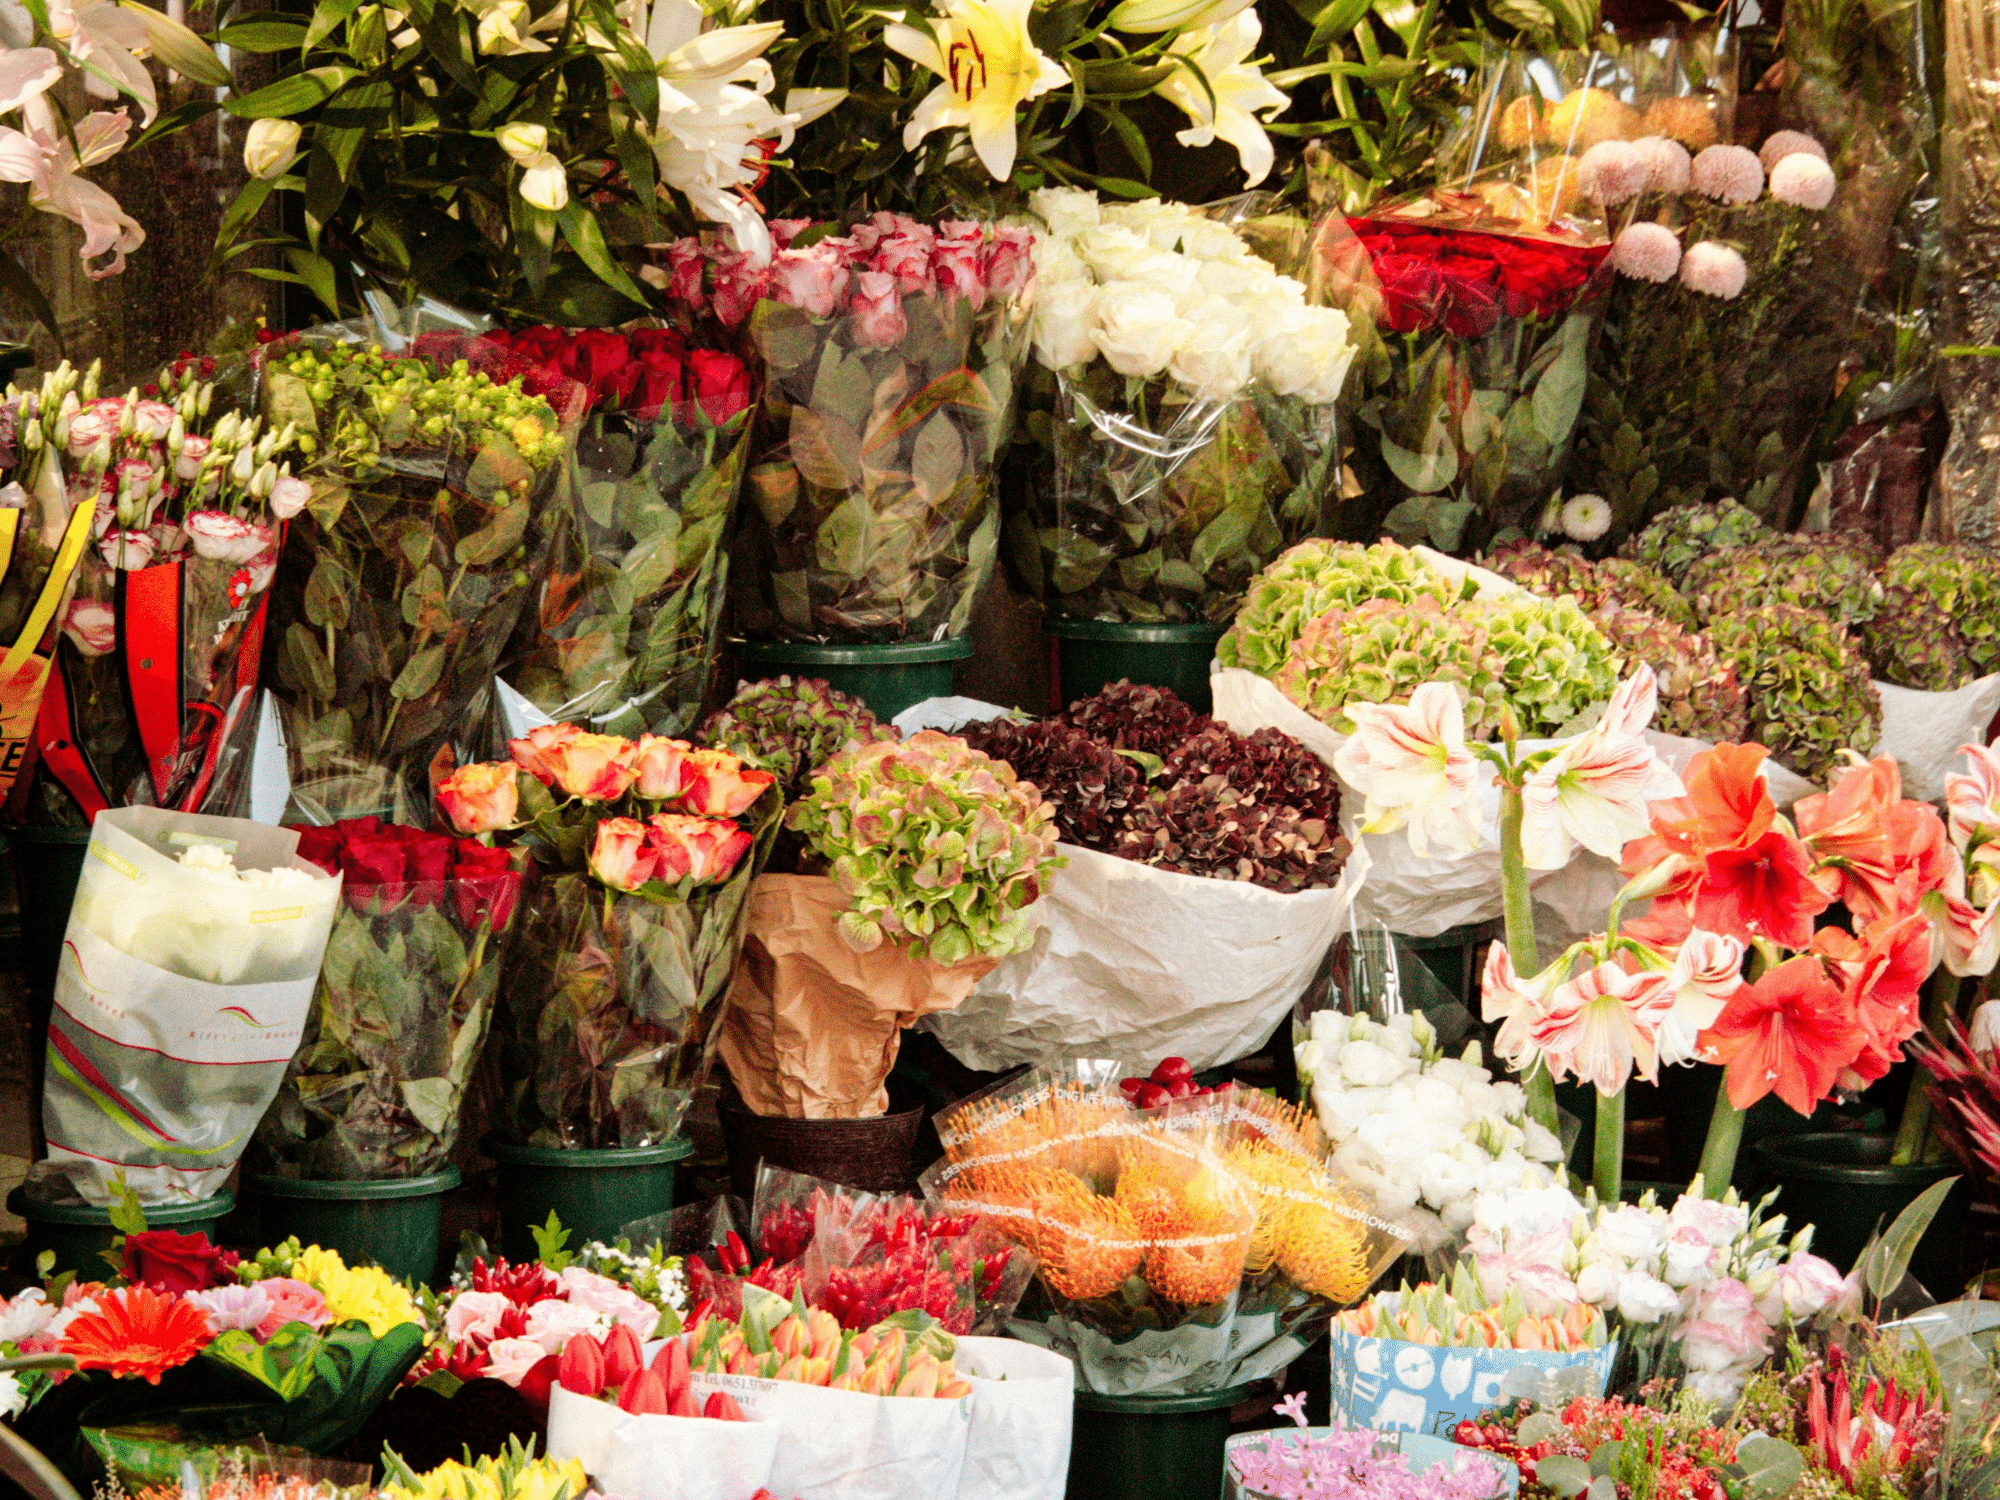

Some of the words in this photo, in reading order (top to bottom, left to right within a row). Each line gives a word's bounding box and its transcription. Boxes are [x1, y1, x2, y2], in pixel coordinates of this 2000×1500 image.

[1334, 1202, 1417, 1241] WILDFLOWERS
[1098, 1238, 1153, 1249] AFRICAN
[1154, 1231, 1237, 1249] WILDFLOWERS
